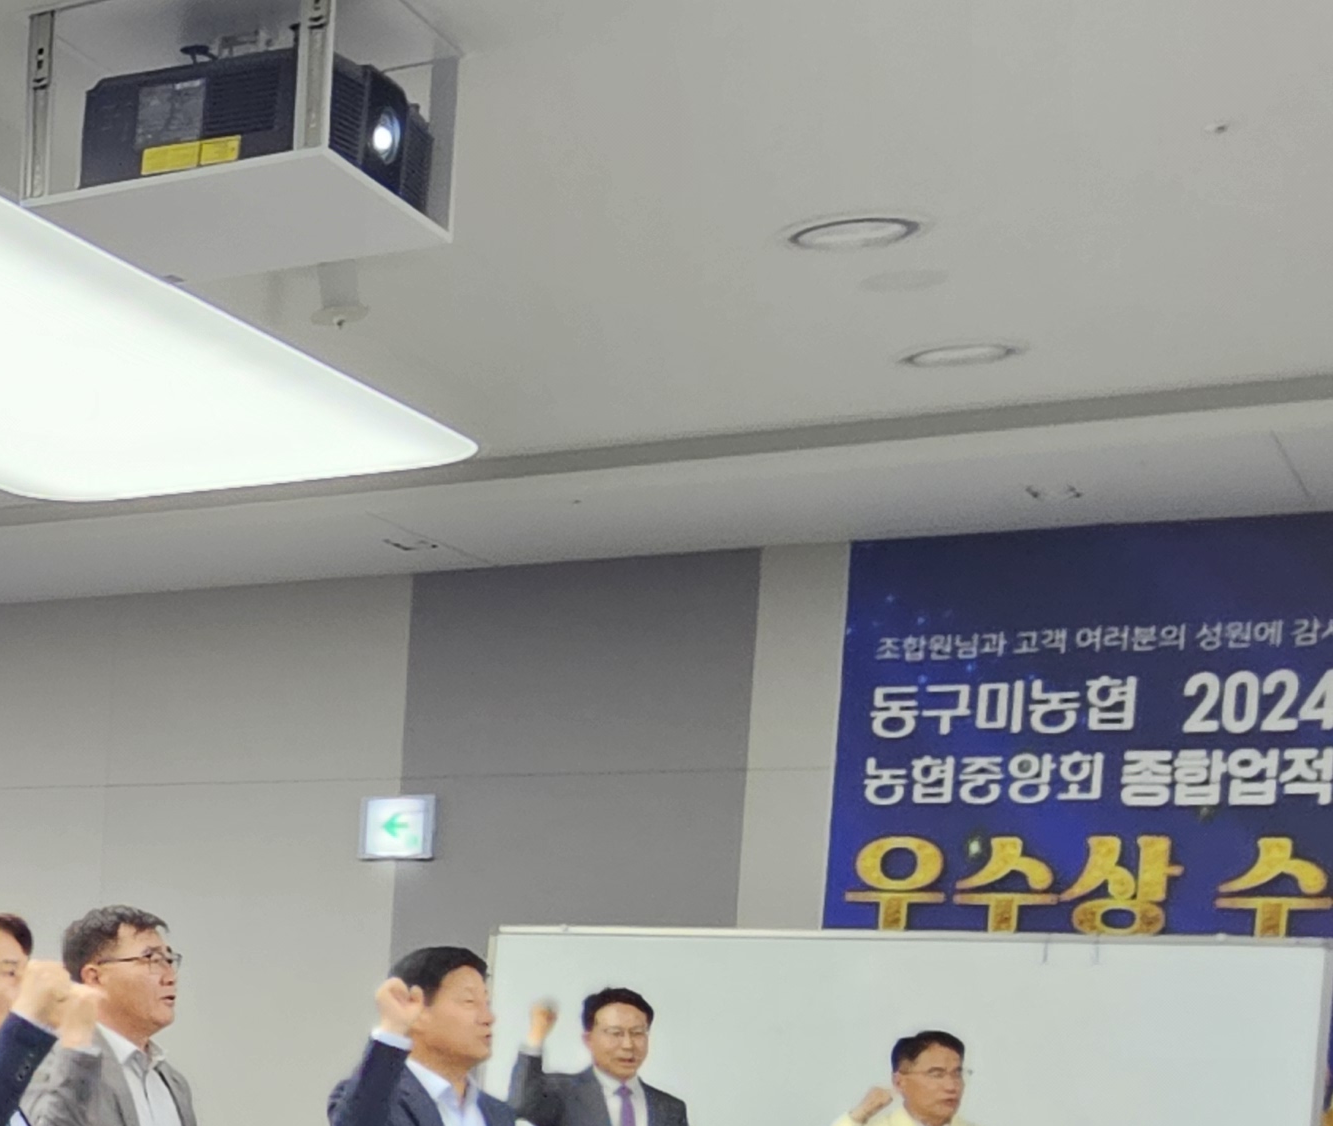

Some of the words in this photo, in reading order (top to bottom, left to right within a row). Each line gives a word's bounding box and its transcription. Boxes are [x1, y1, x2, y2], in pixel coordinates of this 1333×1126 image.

[874, 630, 1008, 662] 조합원님과
[1012, 627, 1068, 654] 고객
[1075, 623, 1186, 653] 여러분의
[1195, 618, 1284, 651] 성원에
[1291, 615, 1333, 648] 감
[870, 675, 1138, 738] 동구미농협
[1182, 668, 1333, 734] 2024
[864, 751, 1104, 805] 농협중앙회
[1120, 746, 1333, 806] 종합업적
[844, 836, 1185, 936] 우수상
